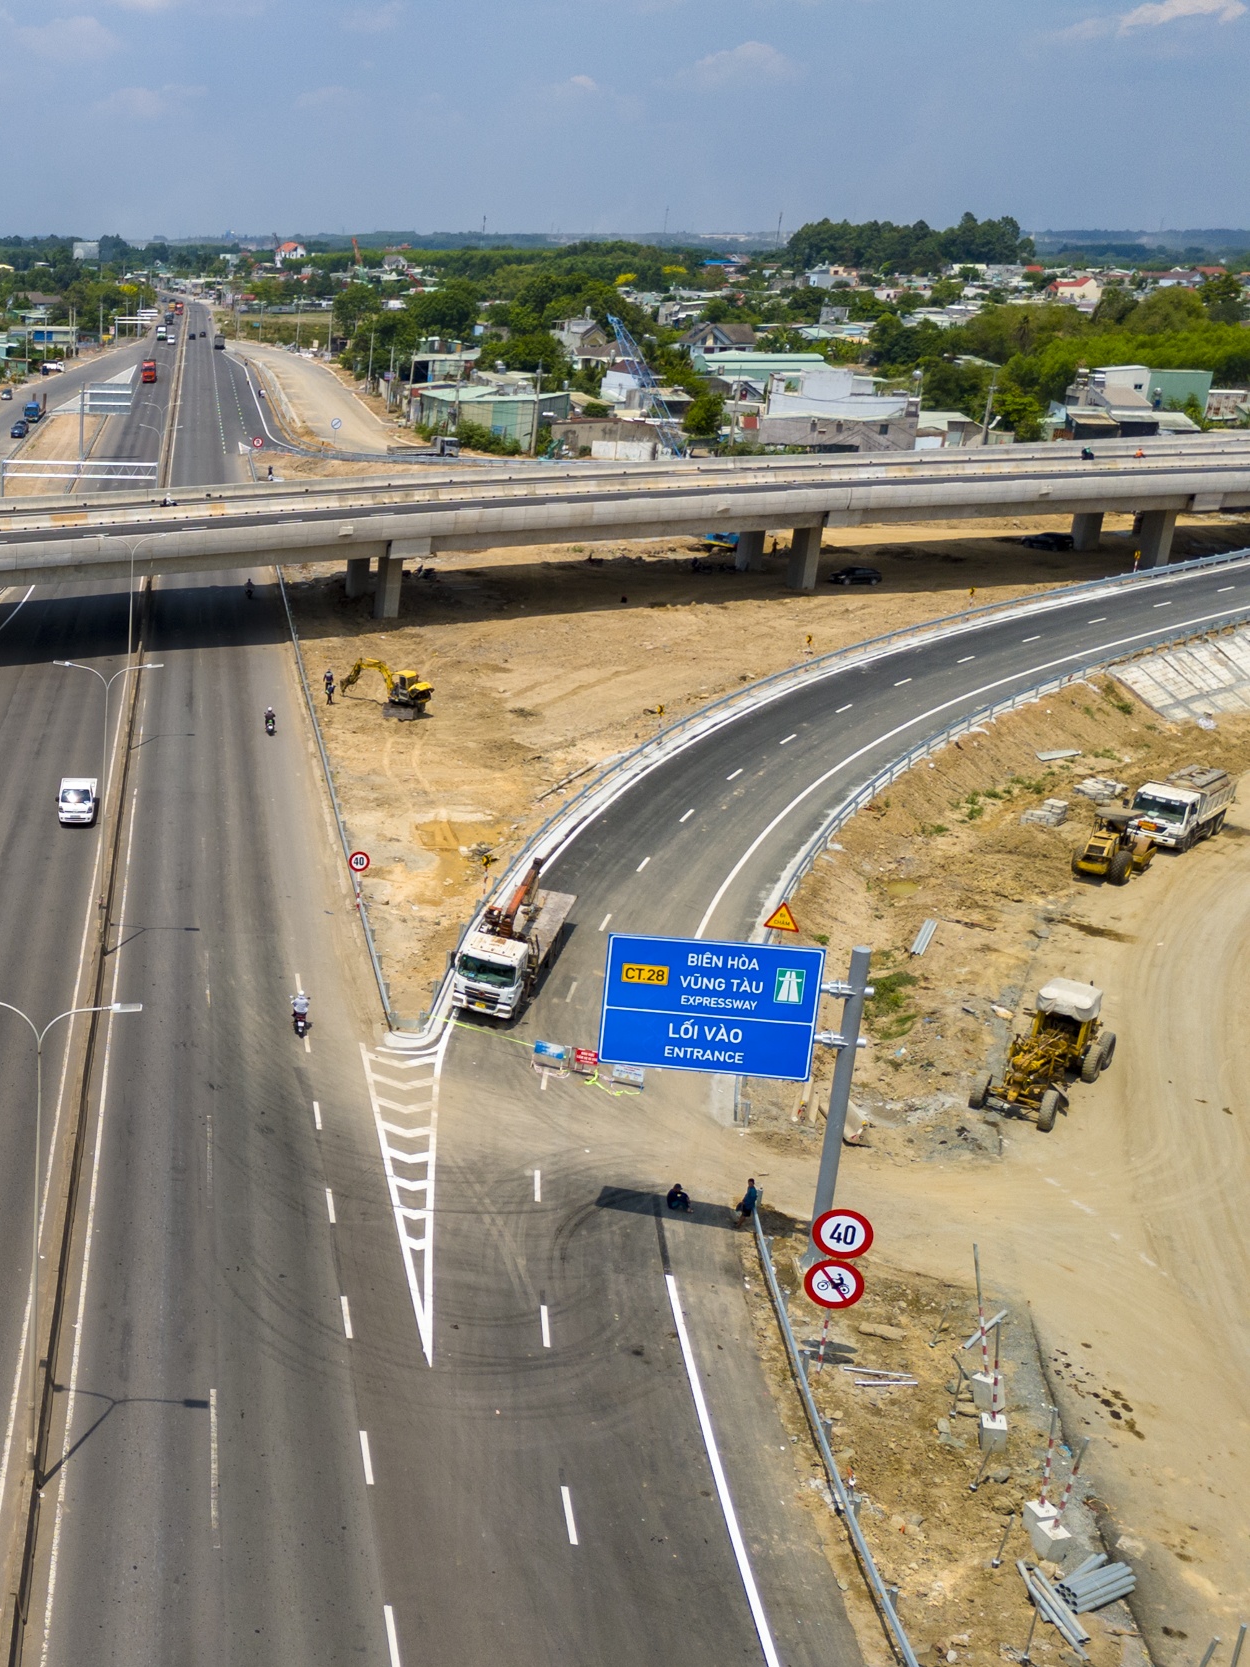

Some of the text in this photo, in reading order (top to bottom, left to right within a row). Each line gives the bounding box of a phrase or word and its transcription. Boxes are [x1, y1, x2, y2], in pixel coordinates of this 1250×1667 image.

[353, 857, 364, 866] 40
[687, 952, 760, 971] BIÊN HÒA
[625, 967, 665, 982] CT.28
[679, 974, 764, 994] VŨNG TÀU
[680, 995, 758, 1011] EXPRESSWAY
[668, 1019, 743, 1044] LỐI VÀO
[664, 1046, 745, 1064] ENTRANCE
[829, 1223, 856, 1245] 40
